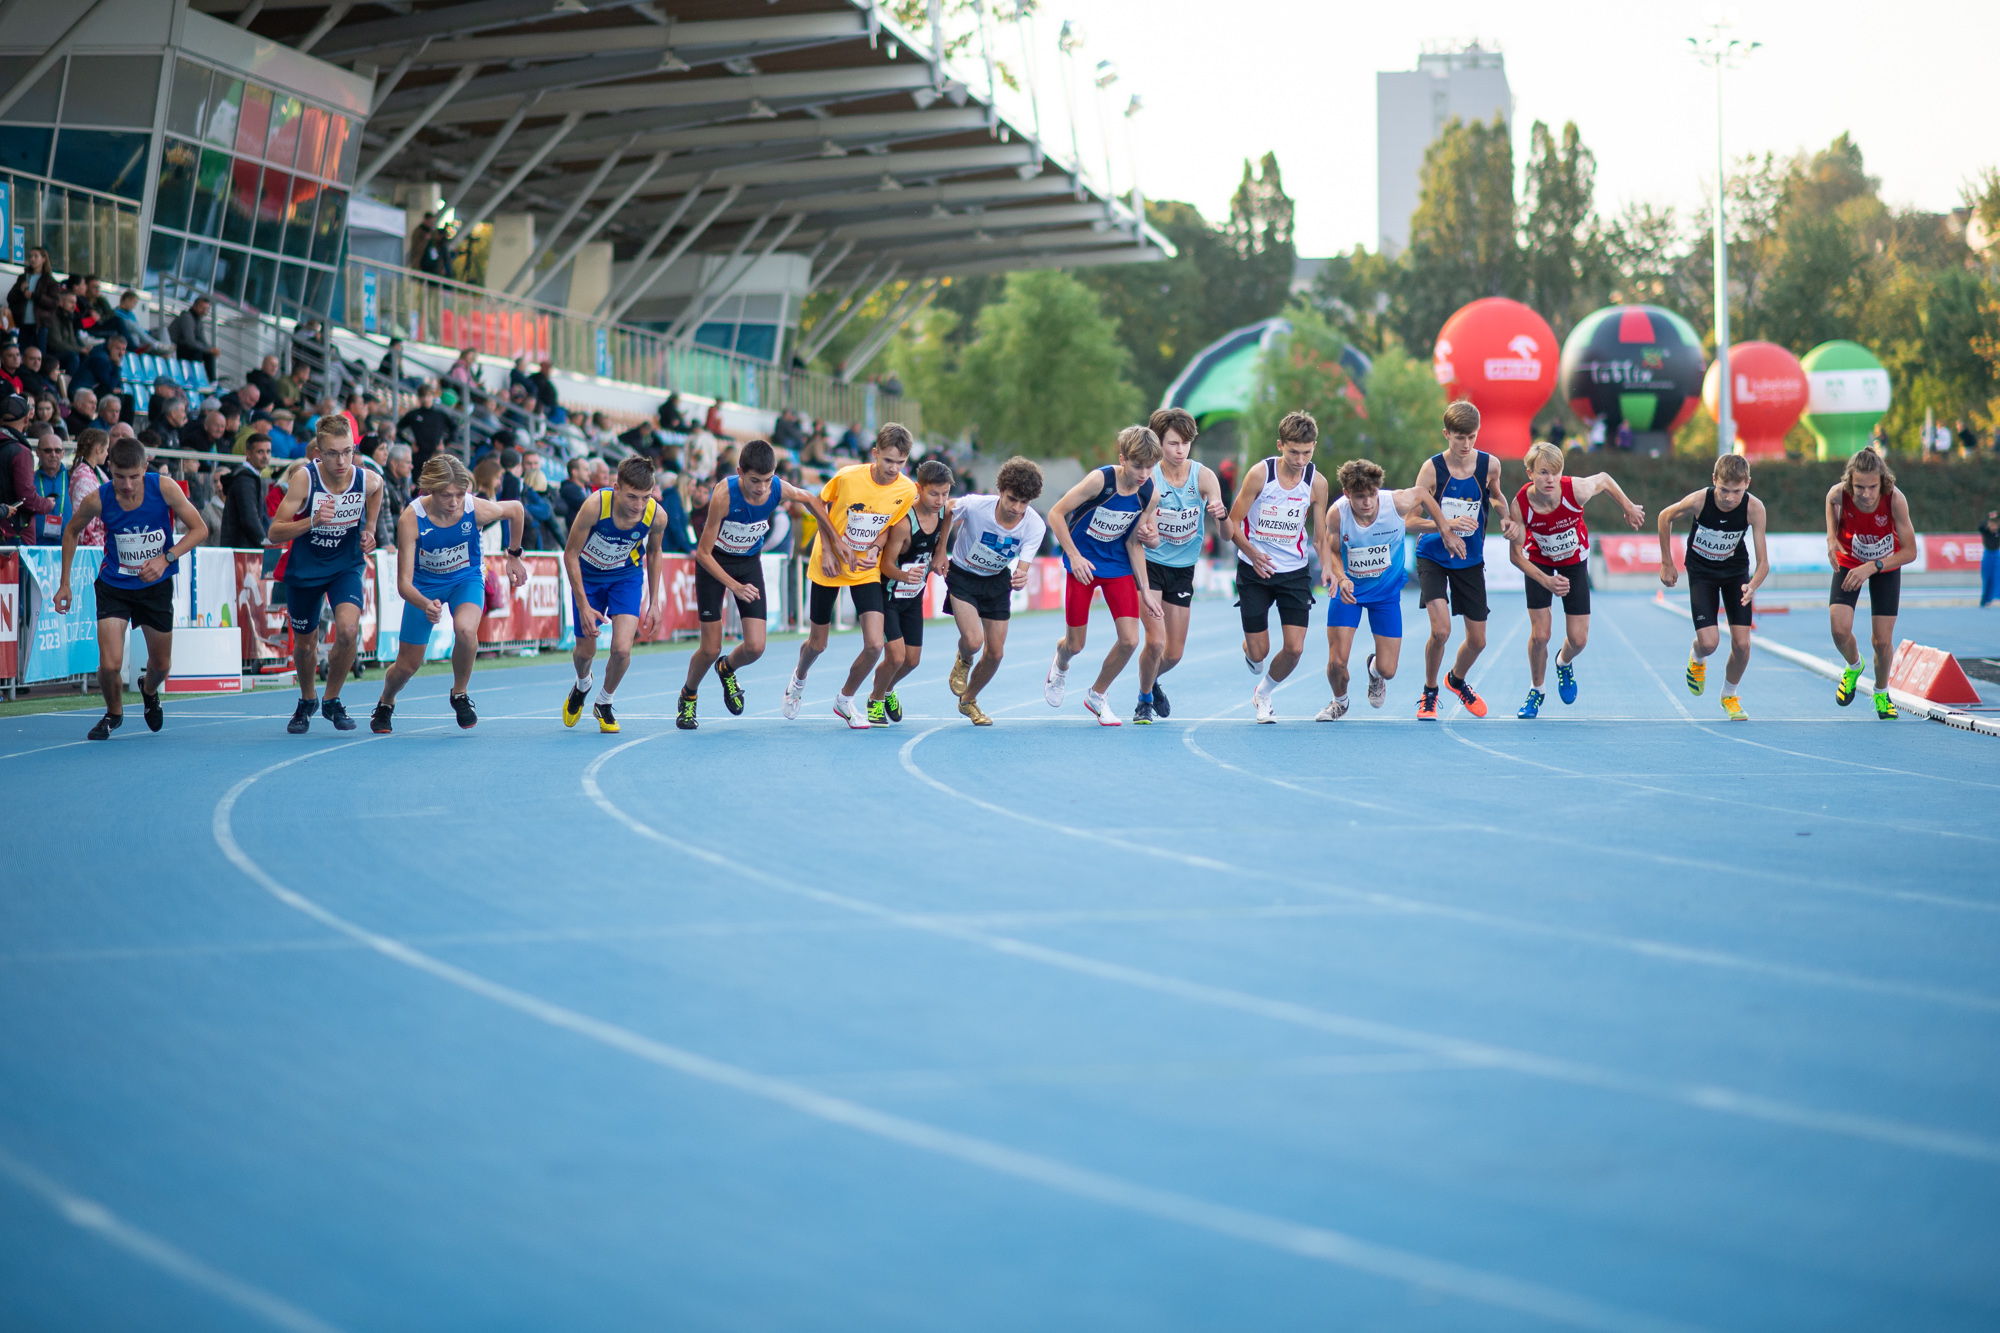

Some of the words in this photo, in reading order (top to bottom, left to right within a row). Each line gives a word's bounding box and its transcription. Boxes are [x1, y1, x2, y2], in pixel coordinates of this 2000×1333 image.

[342, 494, 361, 505] 202
[1181, 508, 1199, 520] 816
[1287, 508, 1300, 518] 61
[749, 522, 767, 533] 579
[1157, 519, 1197, 533] CZERNIK
[140, 532, 163, 545] 700
[311, 535, 341, 548] ŻARY
[1556, 530, 1574, 541] 440
[1722, 532, 1741, 540] 404
[1875, 535, 1892, 549] 349
[446, 544, 466, 556] 798
[1368, 546, 1388, 555] 906
[1853, 544, 1893, 558] PIMPICKI
[425, 555, 463, 568] SURMA
[1350, 557, 1386, 568] JANIAK
